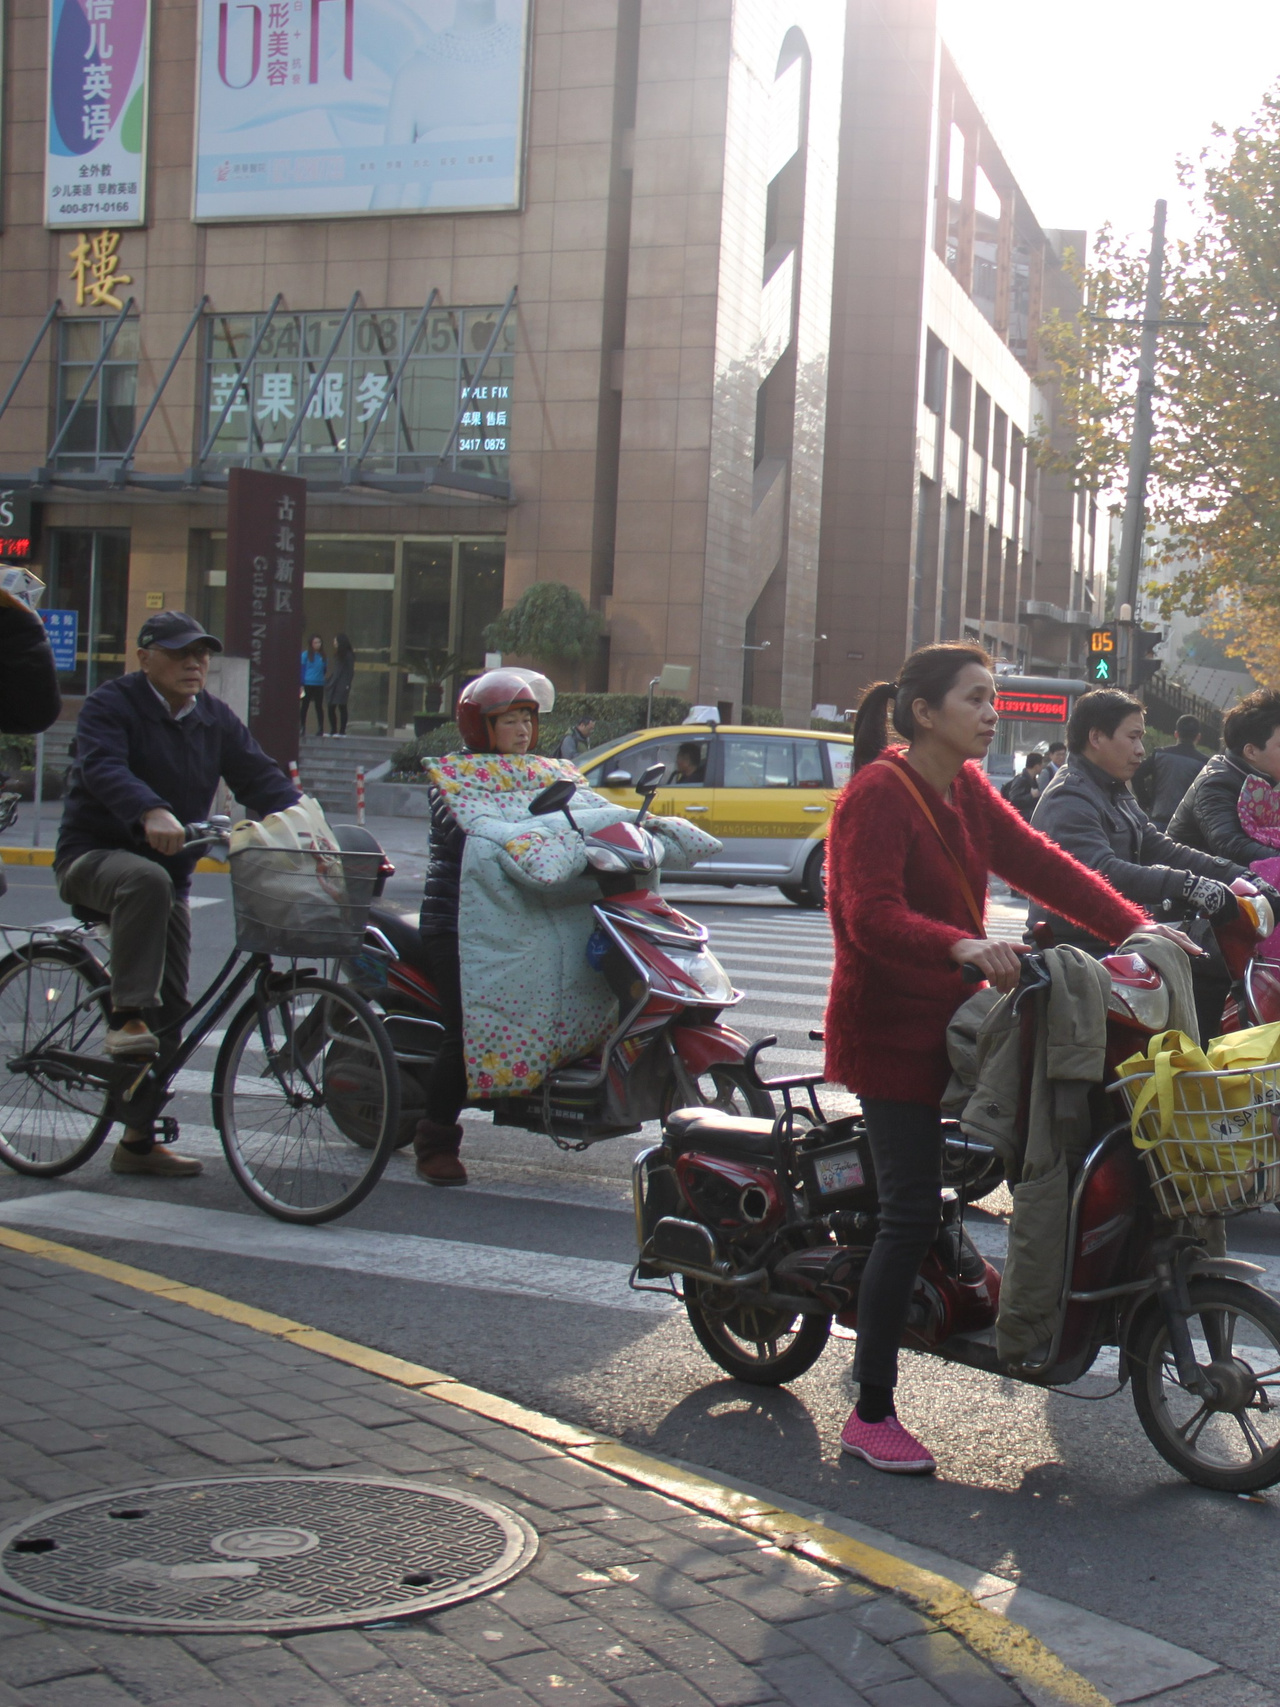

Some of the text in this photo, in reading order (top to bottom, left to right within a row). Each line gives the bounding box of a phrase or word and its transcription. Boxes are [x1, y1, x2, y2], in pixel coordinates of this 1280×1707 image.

[79, 164, 112, 178] 全外教
[52, 182, 137, 197] 少儿英语 早教英语
[59, 202, 129, 214] 400-871-0166
[209, 372, 394, 424] 苹果服务
[491, 386, 509, 399] FIX
[486, 411, 507, 427] 售后
[459, 437, 506, 451] 3417 0875
[274, 495, 296, 613] 古北新区
[1092, 632, 1113, 652] 05
